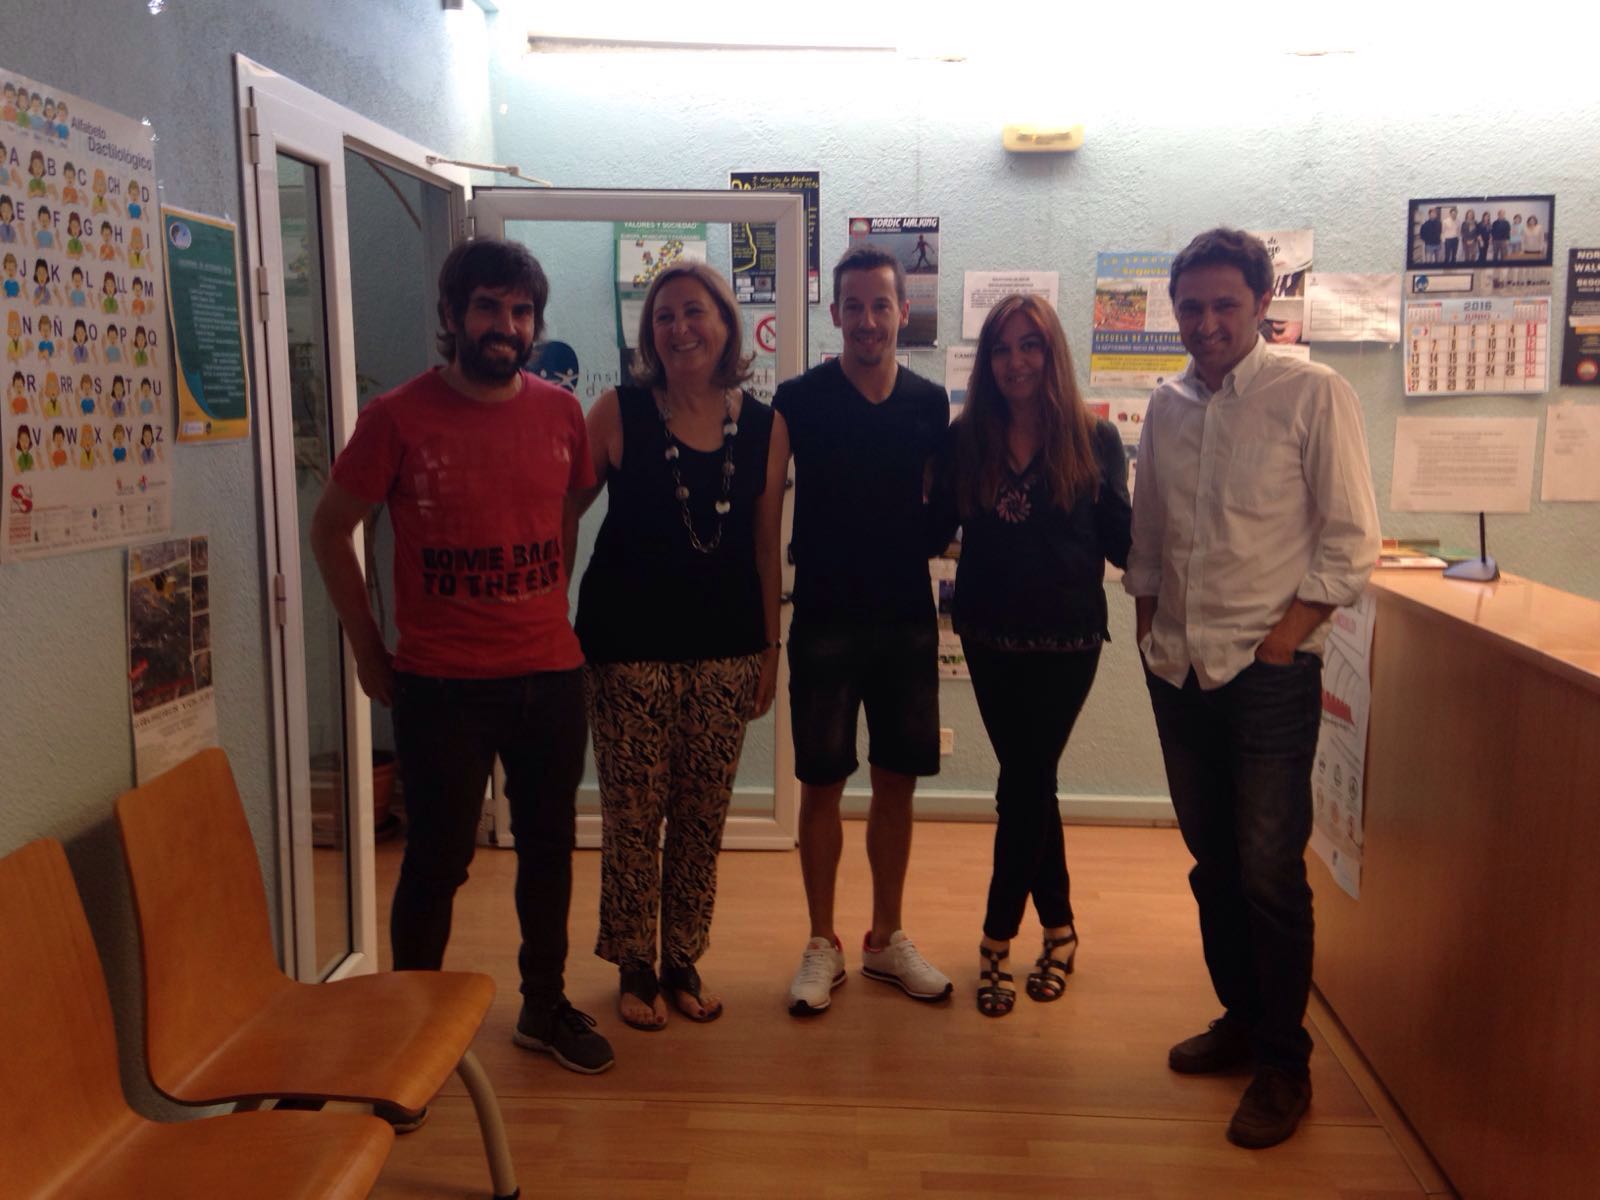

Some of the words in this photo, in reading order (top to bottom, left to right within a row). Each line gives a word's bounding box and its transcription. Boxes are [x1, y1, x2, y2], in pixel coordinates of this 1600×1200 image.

[9, 148, 20, 166] A
[47, 158, 57, 177] B
[77, 168, 87, 186] C
[107, 176, 121, 195] CH
[141, 186, 150, 203] D
[16, 202, 25, 221] E
[52, 211, 61, 228] F
[83, 219, 93, 236] G
[114, 226, 123, 243] H
[872, 218, 901, 228] NORDIC
[902, 217, 938, 228] WALKING
[19, 259, 27, 278] J
[51, 265, 61, 283] K
[86, 271, 93, 288] L
[117, 276, 127, 293] LL
[144, 280, 153, 297] M
[1464, 301, 1492, 311] 2016
[22, 317, 32, 335] N
[53, 316, 63, 337] Ñ
[88, 323, 98, 341] O
[120, 326, 127, 343] P
[148, 330, 157, 346] Q
[1096, 333, 1128, 342] ESCUELA
[1488, 338, 1497, 350] 10
[1508, 338, 1516, 349] 11
[1411, 353, 1420, 365] 13
[1430, 353, 1438, 365] 14
[1487, 352, 1496, 363] 17
[1411, 366, 1420, 378] 20
[1429, 366, 1438, 377] 21
[1447, 366, 1457, 377] 22
[1466, 366, 1476, 377] 23
[1486, 365, 1495, 376] 24
[27, 374, 37, 392] R
[61, 376, 73, 392] RR
[95, 377, 102, 394] S
[125, 379, 132, 394] T
[153, 380, 162, 396] U
[1411, 380, 1420, 391] 27
[1466, 379, 1476, 390] 30
[32, 428, 42, 444] V
[66, 427, 78, 443] W
[95, 428, 102, 443] X
[125, 426, 133, 442] Y
[155, 426, 164, 442] Z
[422, 572, 456, 597] TO
[464, 572, 520, 598] THE
